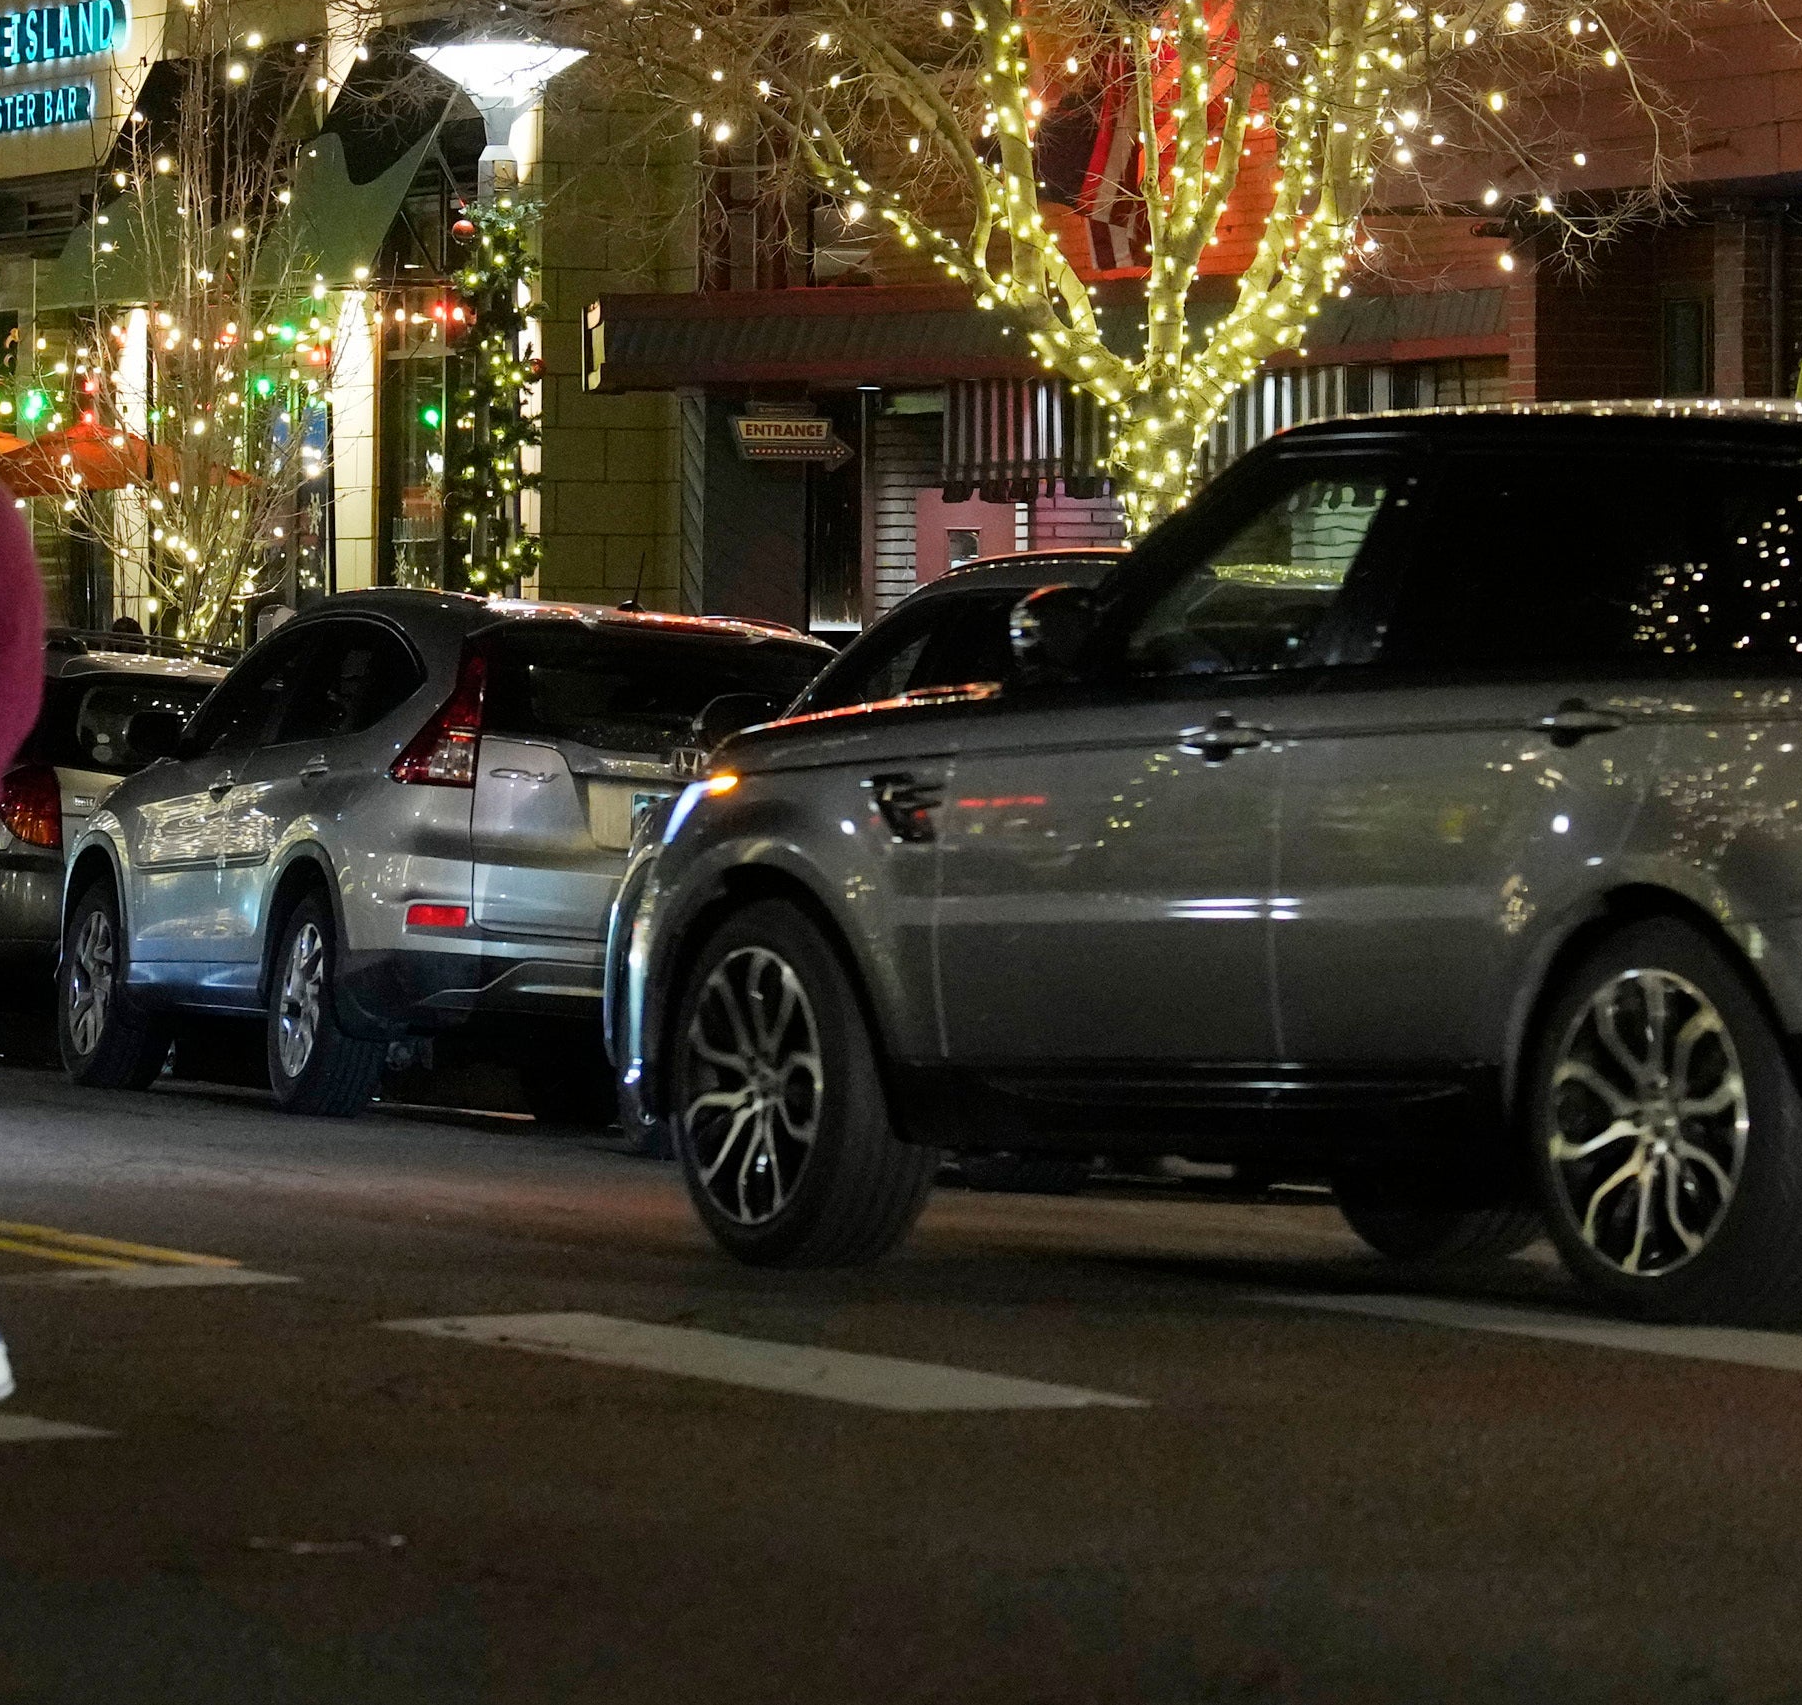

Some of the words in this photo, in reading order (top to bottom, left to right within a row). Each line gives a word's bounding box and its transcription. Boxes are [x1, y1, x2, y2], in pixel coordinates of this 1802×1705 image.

[10, 0, 115, 64] ISLAND
[44, 87, 77, 123] BAR
[745, 424, 823, 436] ENTRANCE
